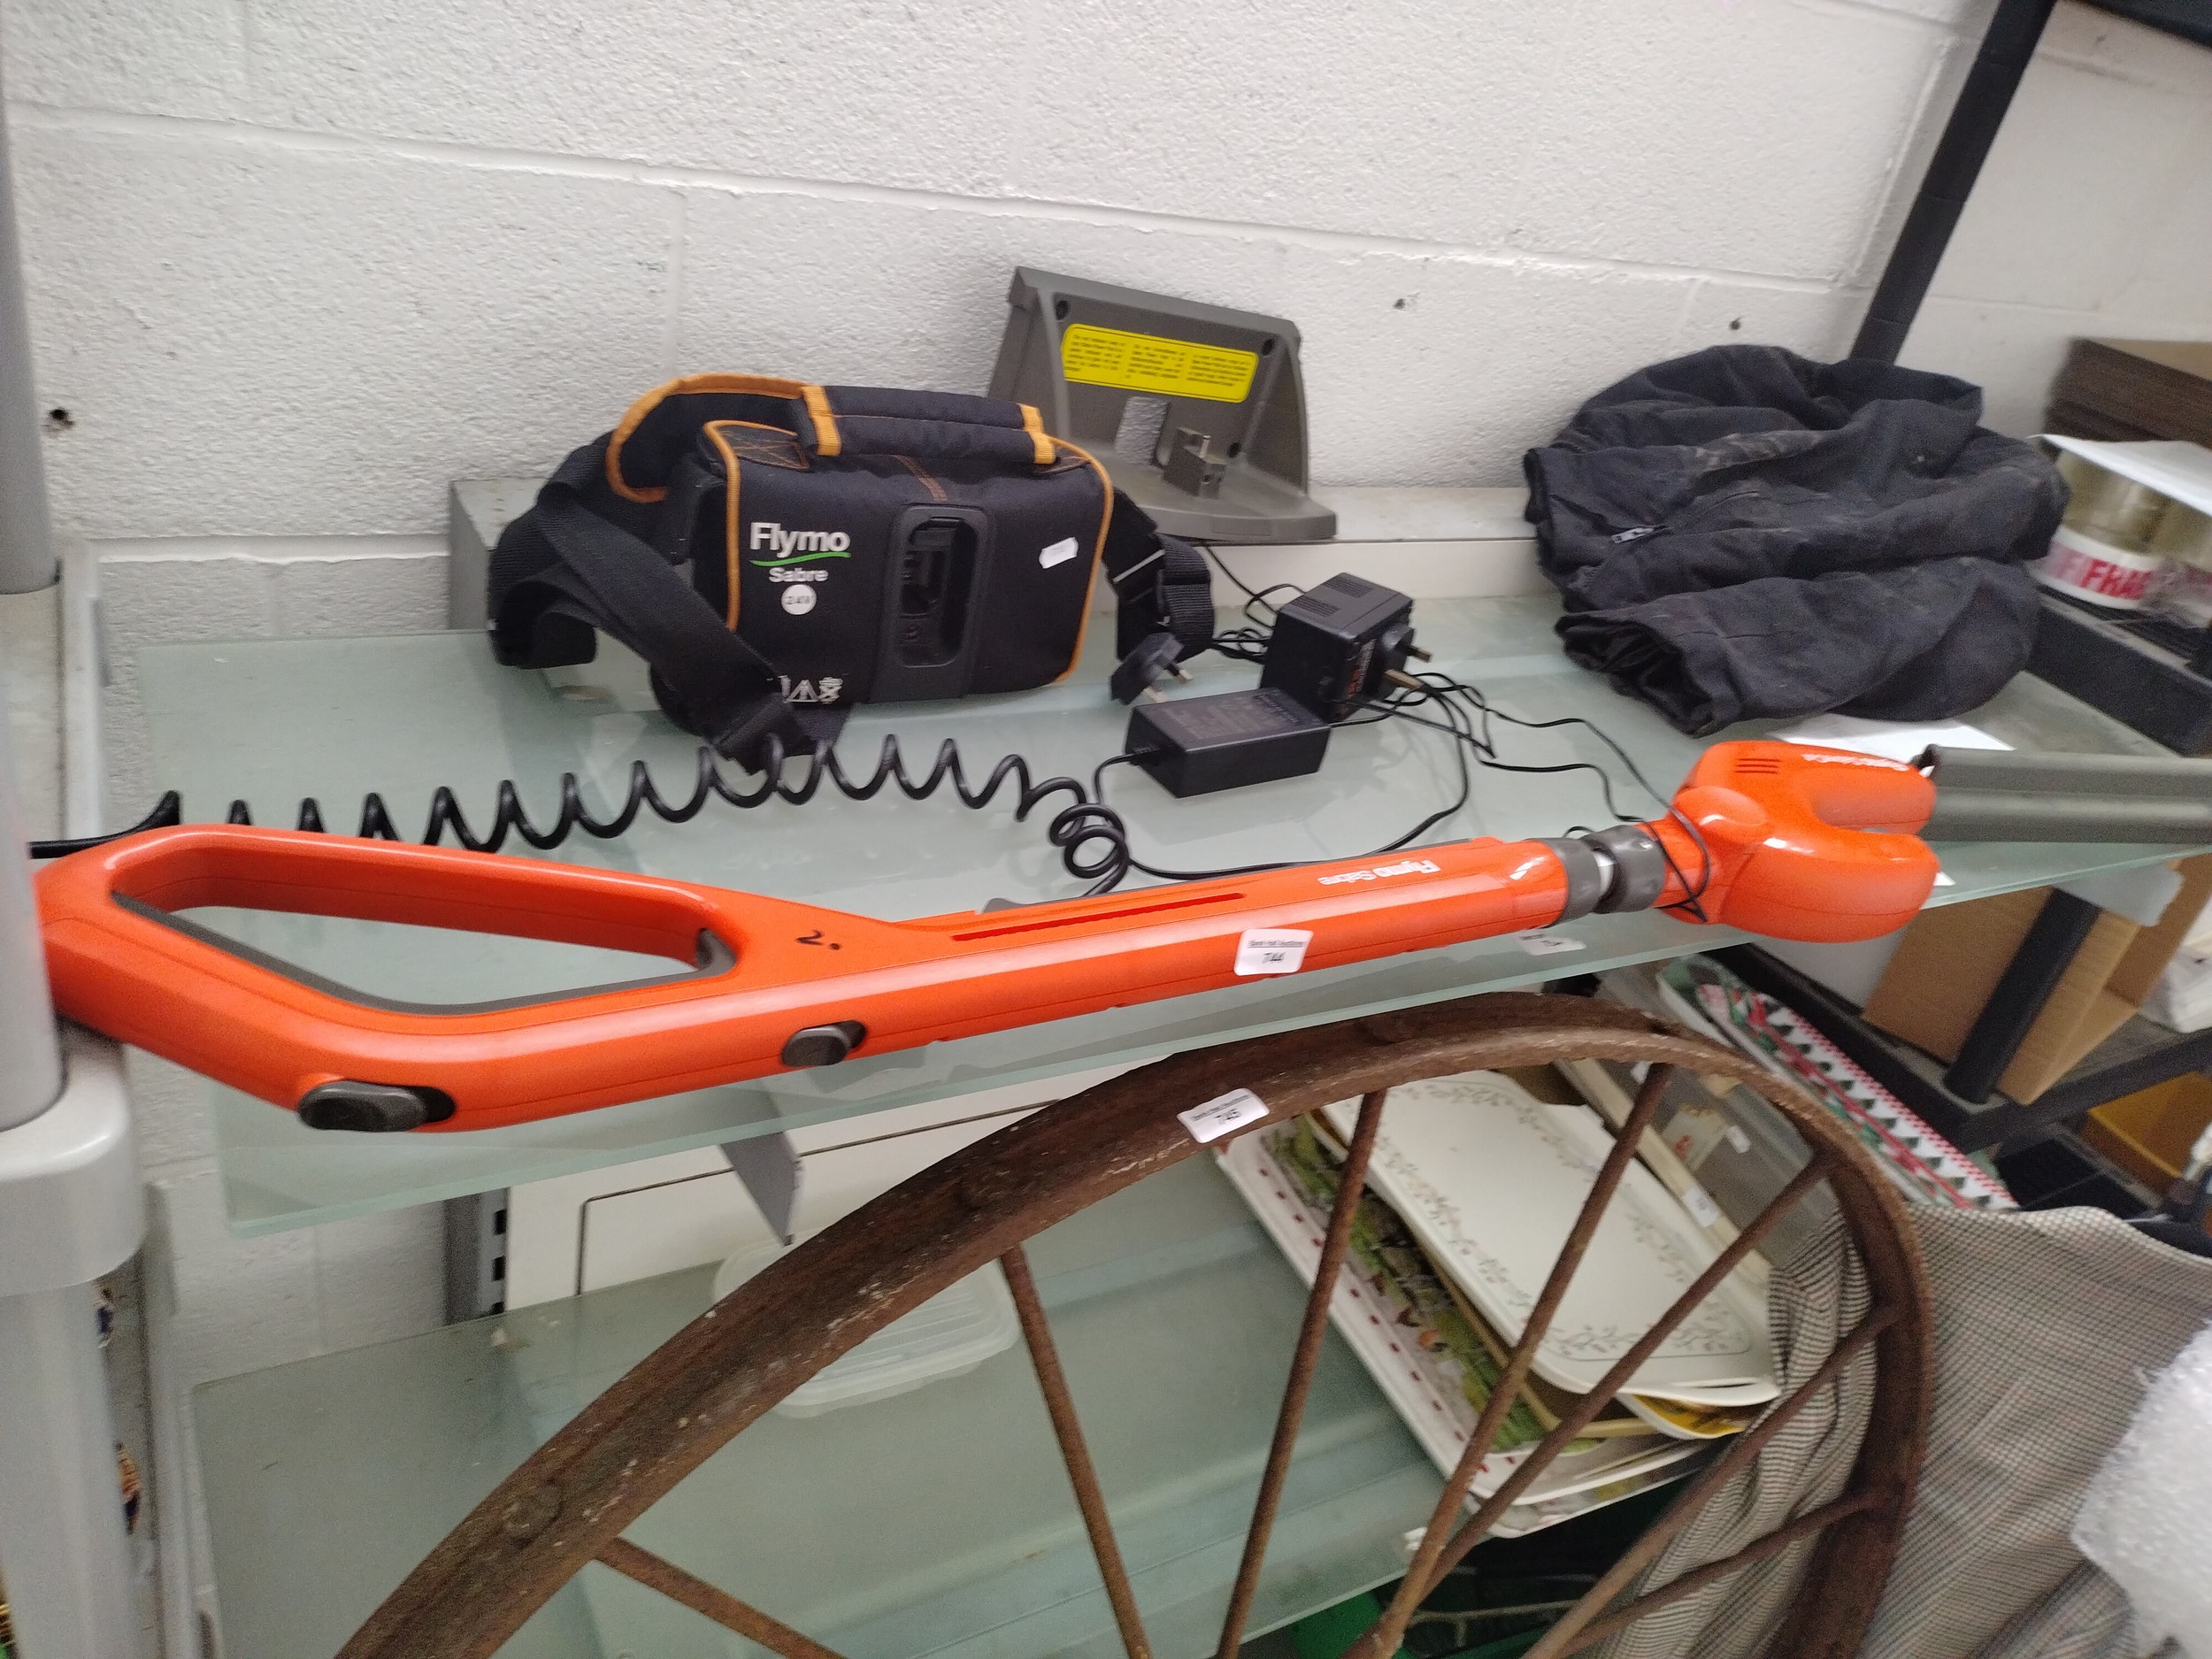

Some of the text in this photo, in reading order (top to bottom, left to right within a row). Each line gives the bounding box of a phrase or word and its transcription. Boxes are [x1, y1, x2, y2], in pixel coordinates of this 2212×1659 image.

[749, 521, 851, 557] Flymo
[768, 566, 829, 583] Sabre
[1261, 951, 1286, 964] 744
